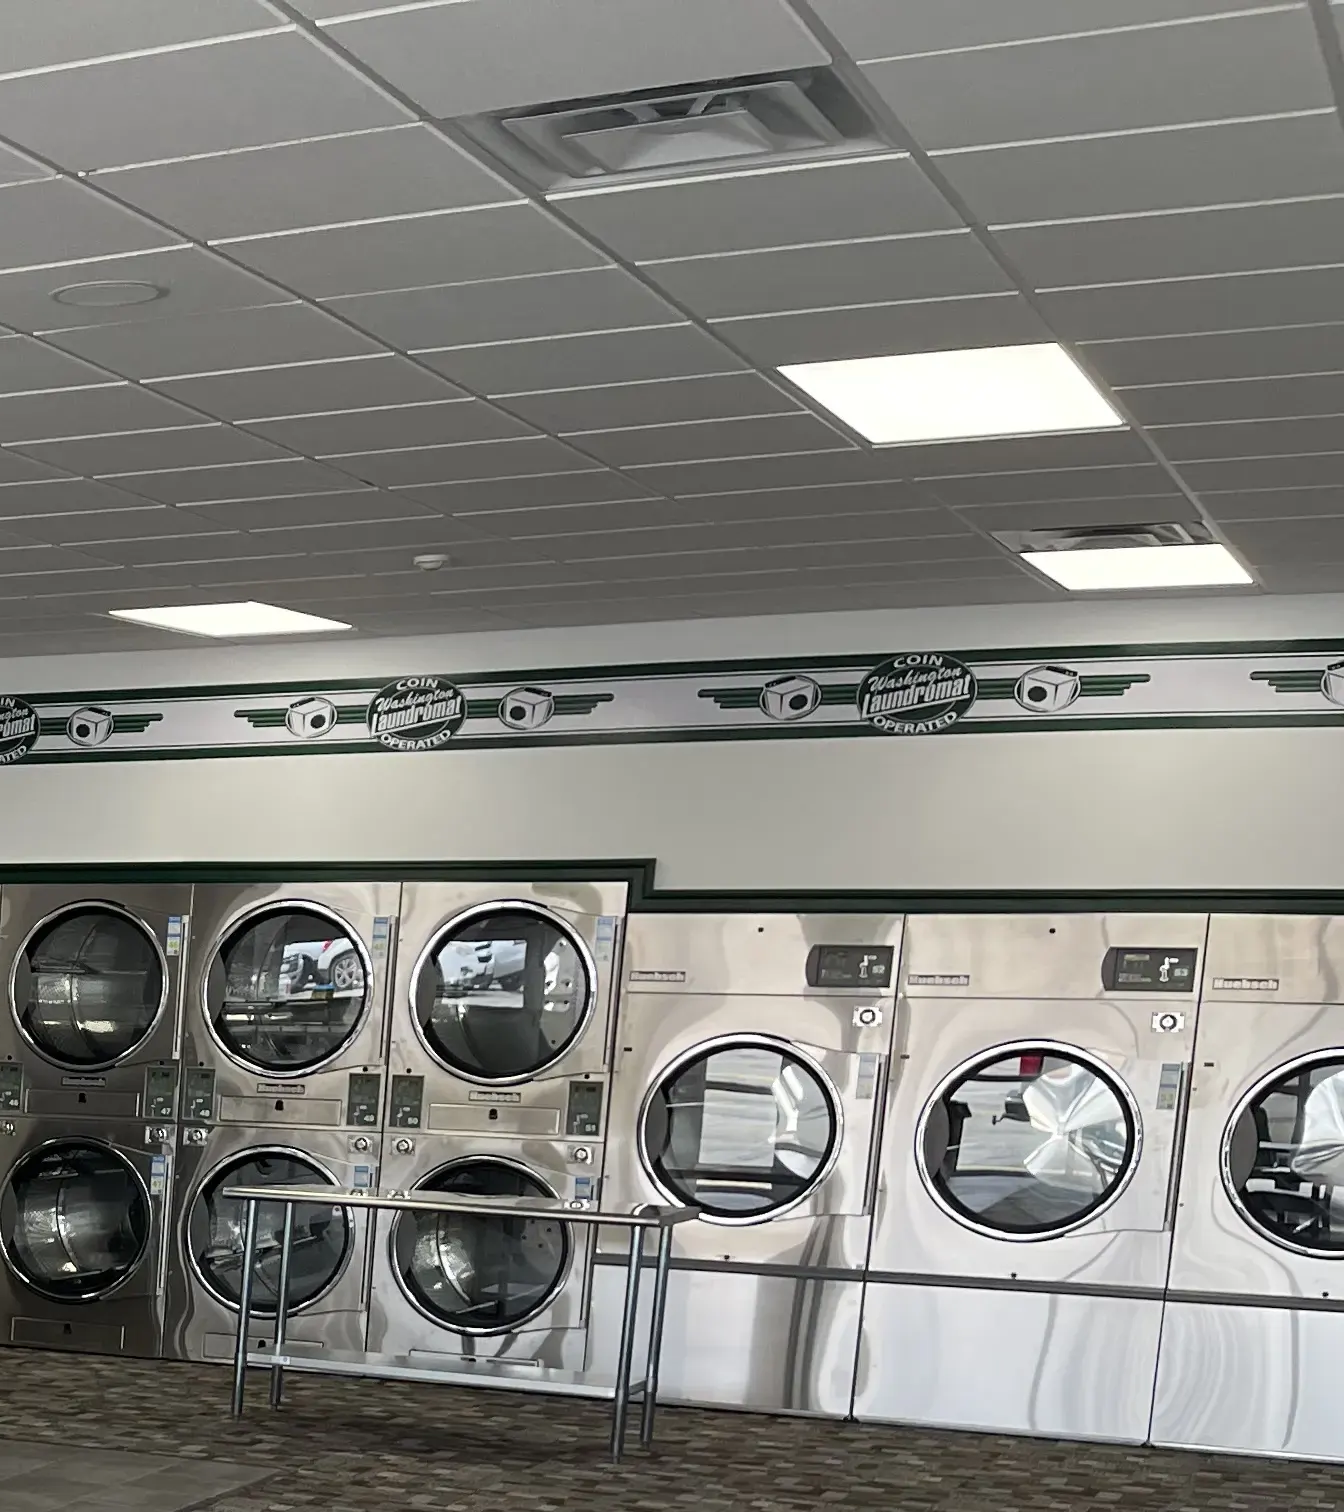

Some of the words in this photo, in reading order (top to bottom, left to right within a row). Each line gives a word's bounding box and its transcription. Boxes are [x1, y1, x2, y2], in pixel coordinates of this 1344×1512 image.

[893, 655, 943, 668] COIN
[396, 678, 438, 690] COIN
[868, 667, 962, 691] Washington
[375, 689, 454, 711] Washington
[862, 674, 971, 718] Laundromat
[372, 696, 462, 736] Laundromat
[873, 711, 957, 733] OPERATED
[381, 730, 451, 749] OPERATED
[160, 1107, 171, 1115] 47
